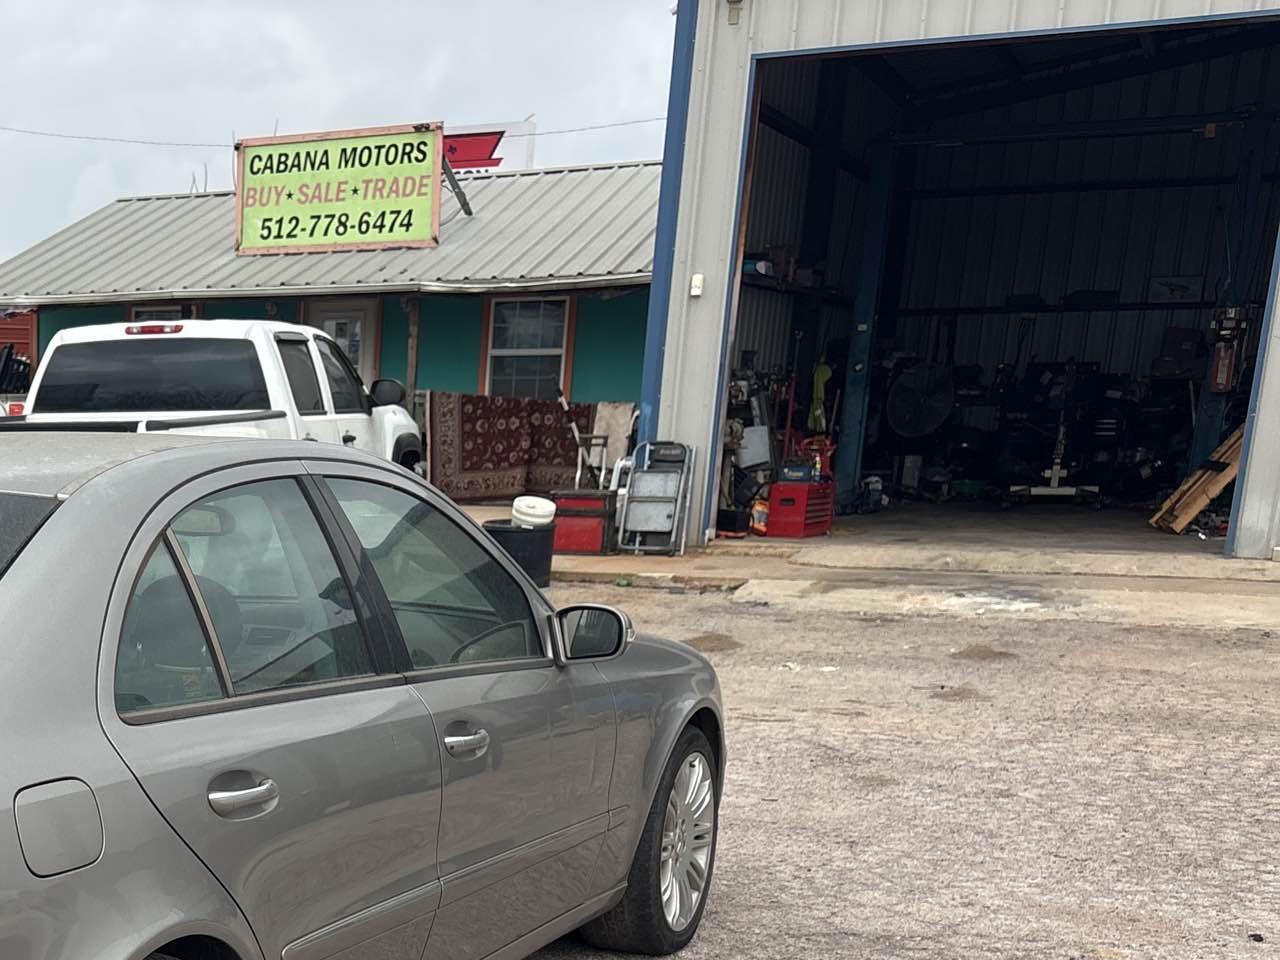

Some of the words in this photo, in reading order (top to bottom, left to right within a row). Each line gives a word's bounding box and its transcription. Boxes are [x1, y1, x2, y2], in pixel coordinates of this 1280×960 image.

[249, 149, 330, 175] CABANA
[337, 141, 428, 169] MOTORS
[244, 185, 286, 209] BUY
[297, 180, 348, 205] SALE
[360, 174, 432, 201] TRADE
[260, 209, 413, 240] 512-778-6474
